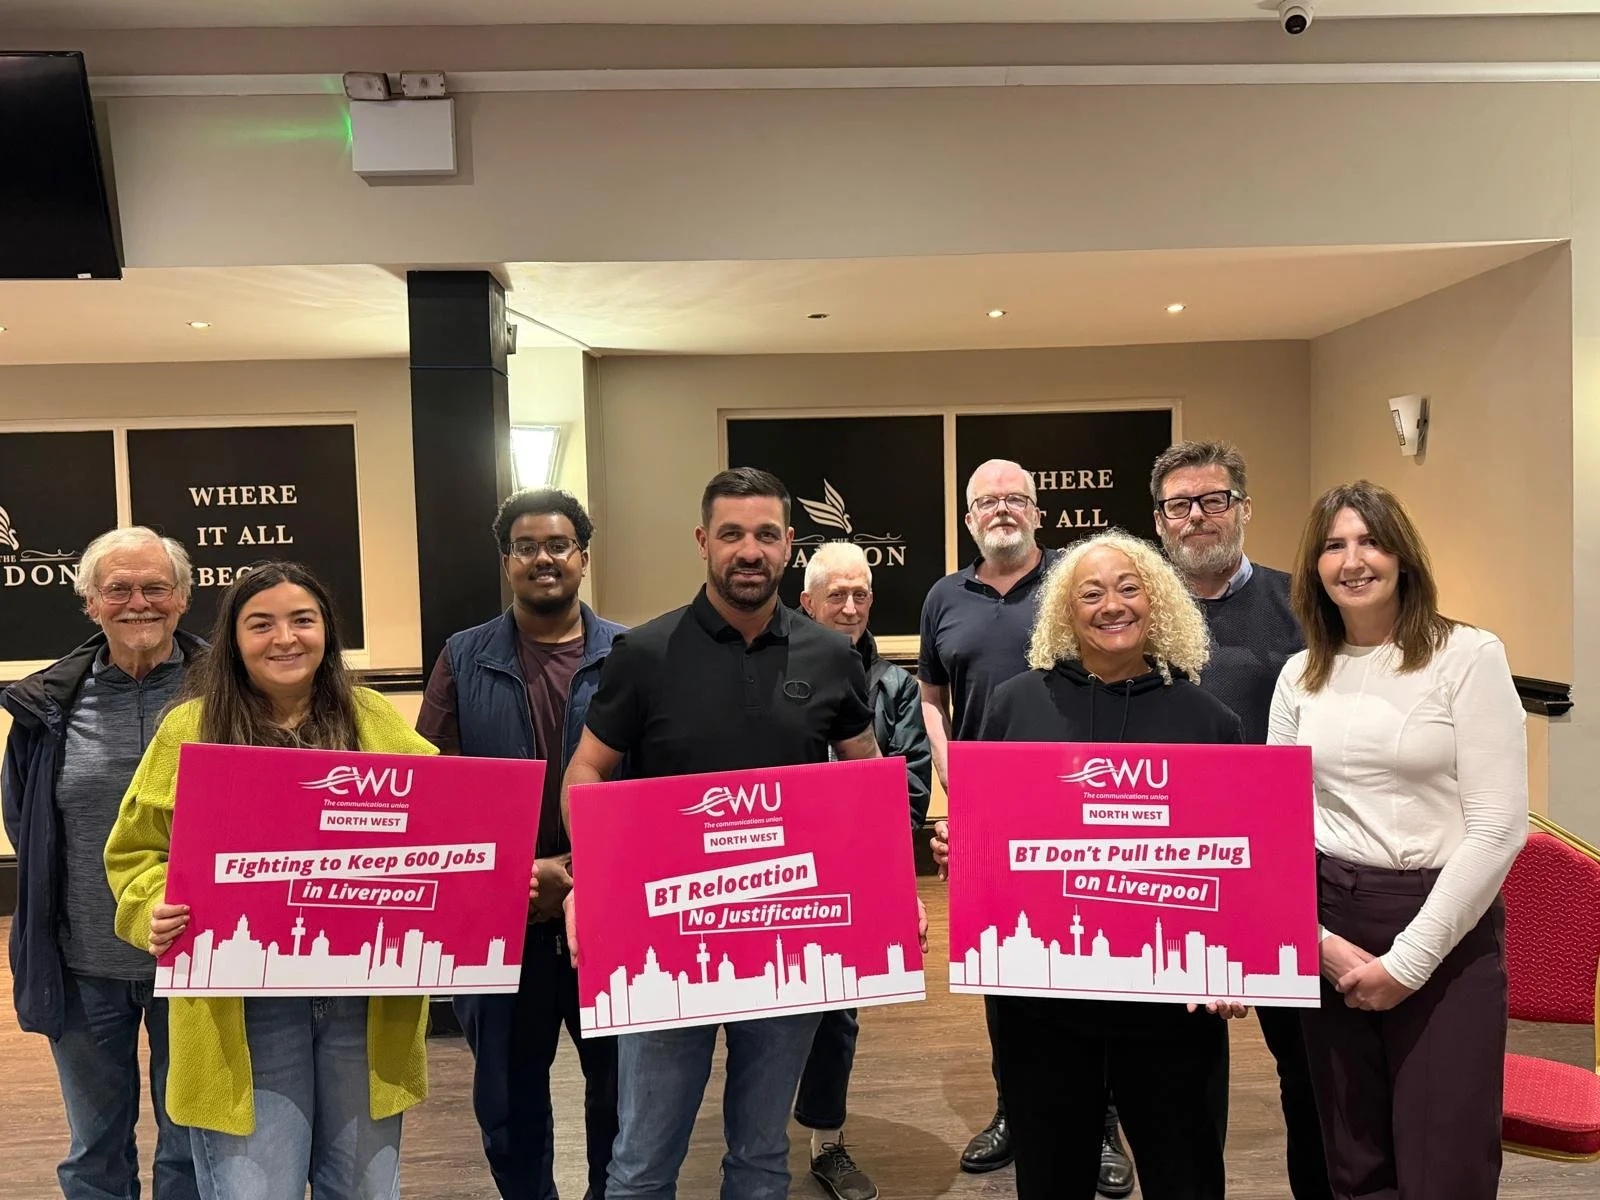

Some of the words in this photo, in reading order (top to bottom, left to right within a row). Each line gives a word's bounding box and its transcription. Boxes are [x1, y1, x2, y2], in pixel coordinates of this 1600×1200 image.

[1029, 469, 1114, 490] HERE
[189, 485, 298, 506] WHERE
[1056, 508, 1108, 528] ALL
[197, 526, 228, 546] IT
[237, 525, 294, 545] ALL
[325, 766, 414, 797] CWU
[1082, 758, 1168, 789] CWU
[703, 782, 782, 816] CWU
[1095, 792, 1149, 800] communications
[327, 816, 367, 826] NORTH
[371, 817, 401, 827] WEST
[715, 818, 765, 828] communications
[1089, 810, 1129, 819] NORTH
[1132, 811, 1163, 820] WEST
[710, 835, 747, 847] NORTH
[750, 832, 778, 842] WEST
[225, 856, 315, 878] Fighting
[320, 857, 341, 871] to
[347, 854, 398, 872] Keep
[404, 851, 440, 867] 600
[440, 849, 486, 869] Jobs
[1015, 846, 1040, 862] BT
[1046, 846, 1101, 862] Don't
[1107, 844, 1148, 862] Pull
[1154, 844, 1190, 861] the
[1197, 843, 1244, 865] Plug
[302, 881, 323, 898] in
[327, 882, 425, 905] Liverpool
[654, 884, 682, 907] BT
[688, 864, 809, 901] Relocation
[1074, 874, 1100, 891] on
[1106, 874, 1209, 902] Liverpool
[688, 909, 716, 926] No
[718, 901, 842, 929] Justification
